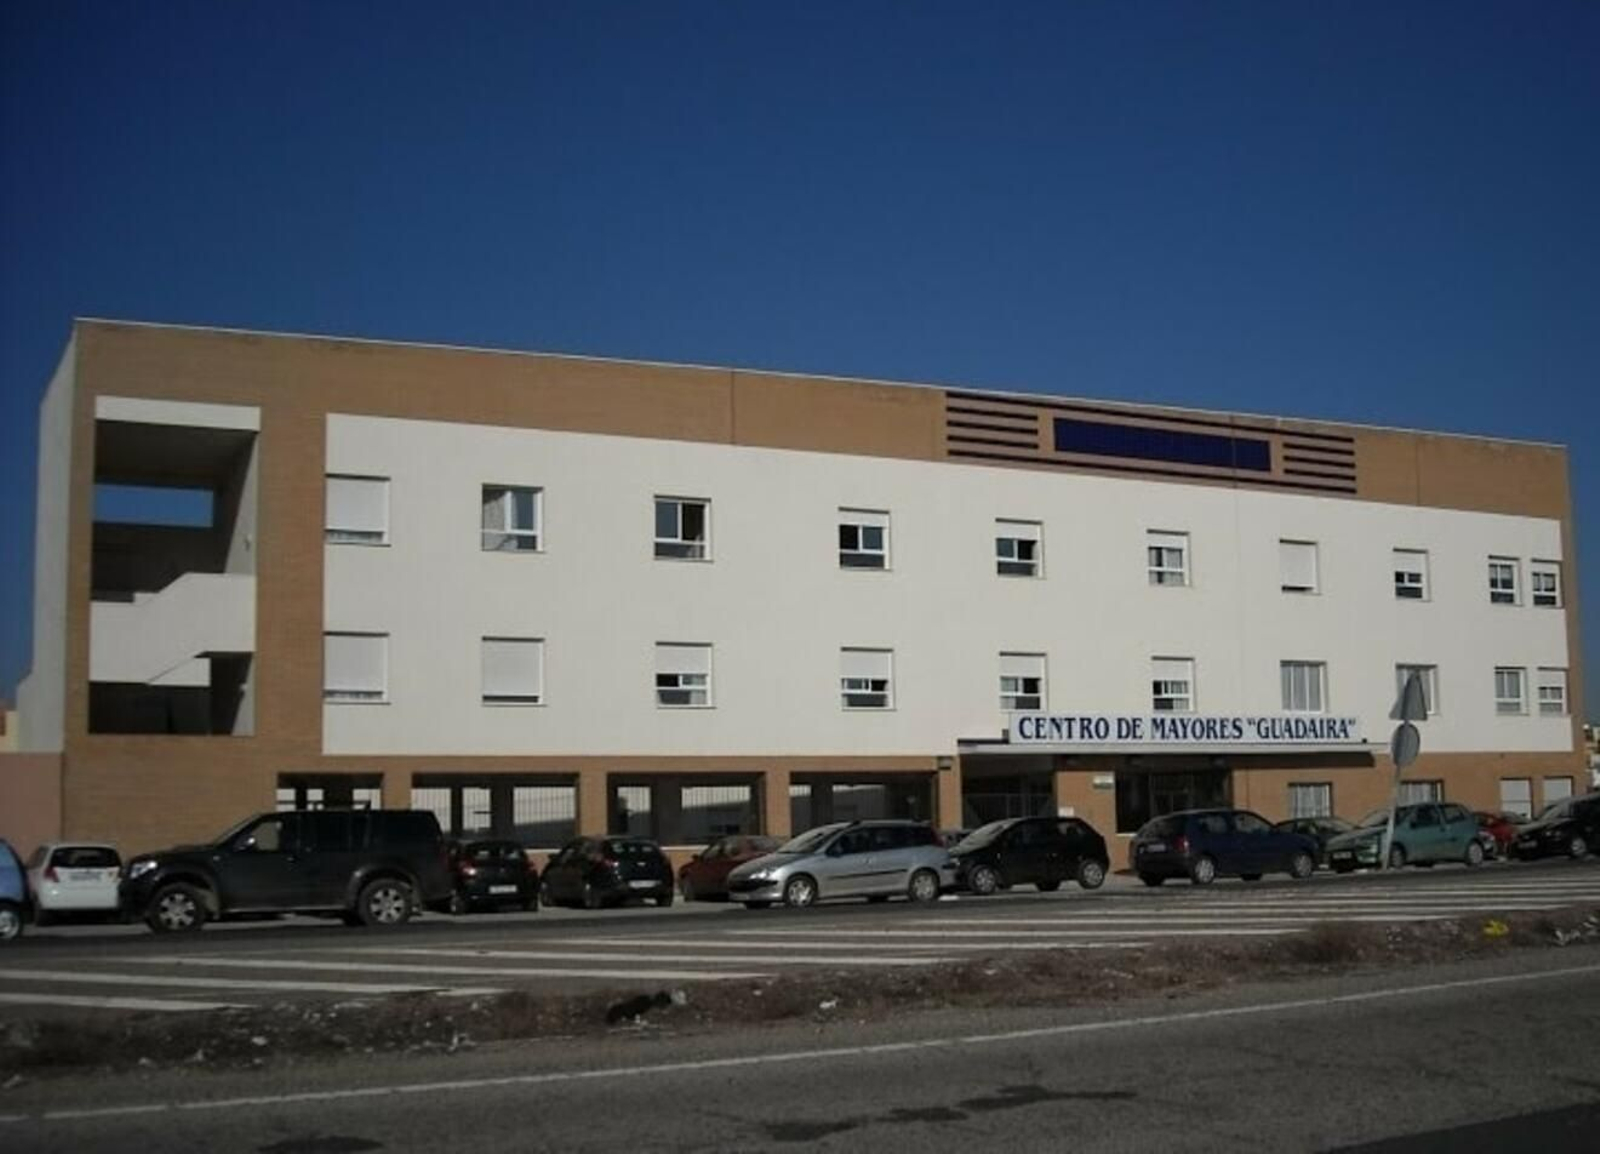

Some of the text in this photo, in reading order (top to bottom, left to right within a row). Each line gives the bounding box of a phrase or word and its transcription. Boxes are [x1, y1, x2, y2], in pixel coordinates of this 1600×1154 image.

[1018, 716, 1356, 740] CENTRO DE MAYORES "GUADAIRA"
